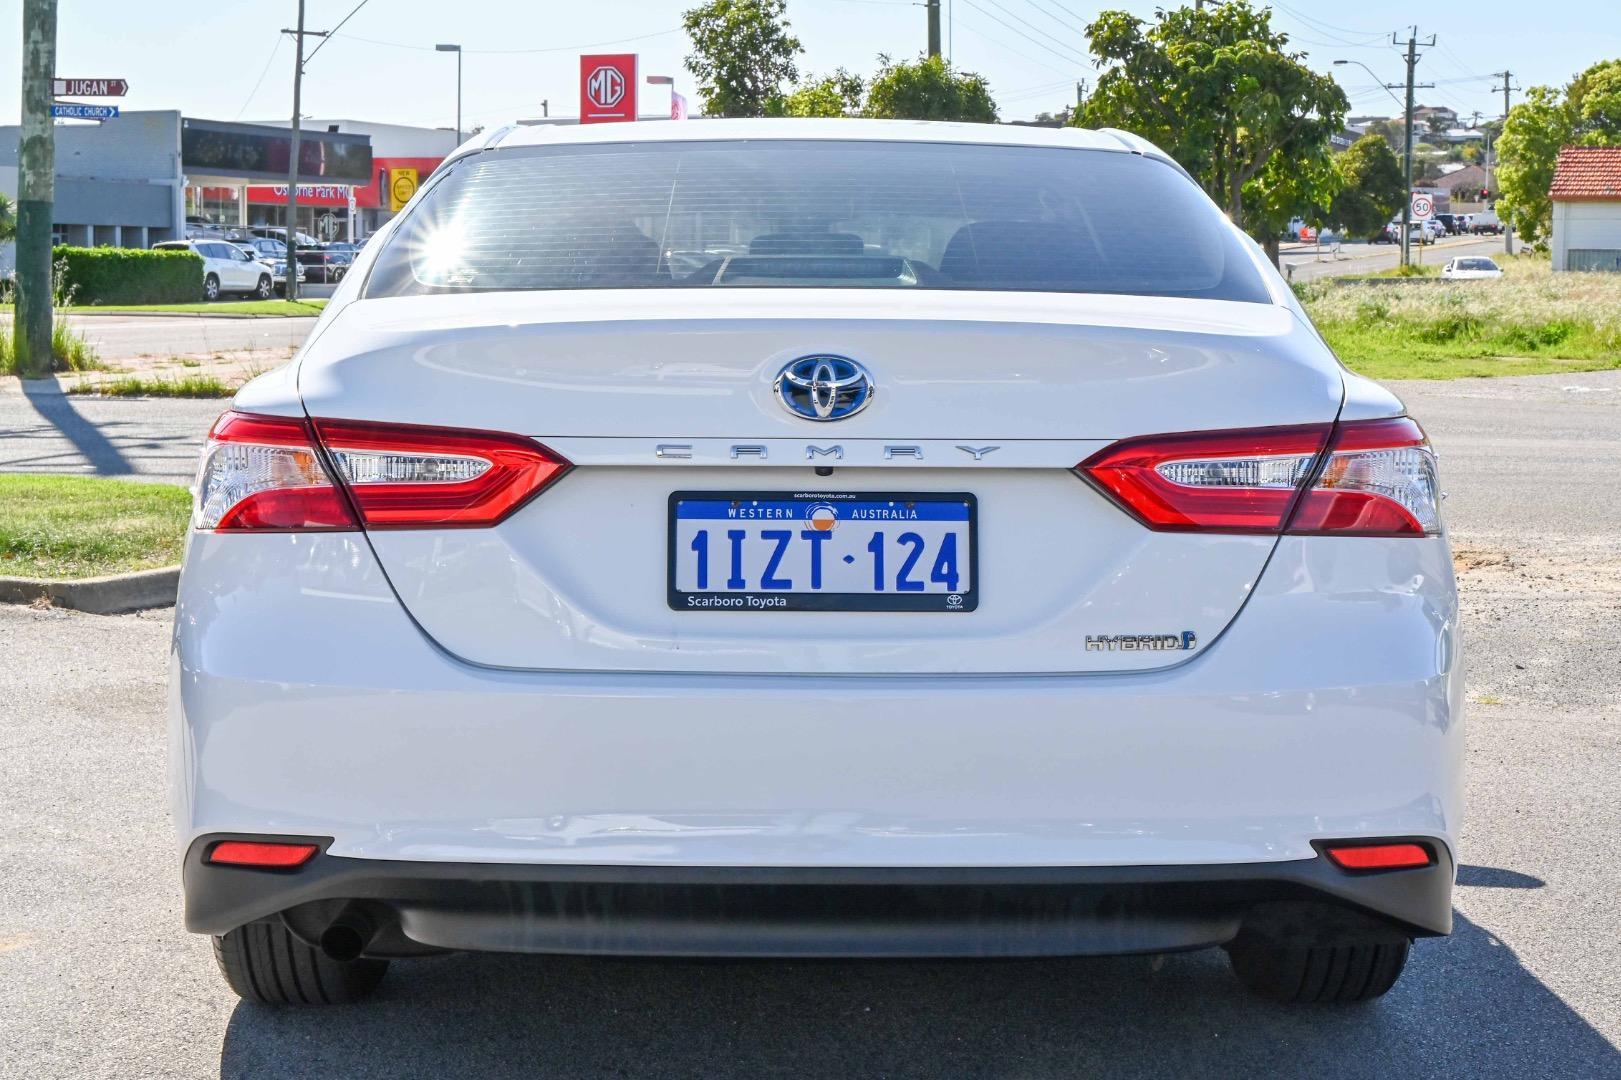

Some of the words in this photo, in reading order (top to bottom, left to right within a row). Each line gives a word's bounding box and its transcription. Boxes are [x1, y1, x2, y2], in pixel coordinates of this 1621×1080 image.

[67, 80, 108, 95] JUGAN
[590, 68, 623, 105] MG
[54, 106, 82, 116] CATHOLIC
[84, 107, 108, 117] CHURCH
[1416, 202, 1428, 212] 50
[656, 445, 1001, 460] CAMRY
[793, 491, 857, 499] scarborotoyota.com.au
[728, 508, 793, 518] WESTERN
[851, 509, 918, 519] AUSTRALIA
[687, 596, 744, 607] Scarboro
[745, 596, 787, 608] Toyota
[1085, 634, 1178, 651] HYBRID
